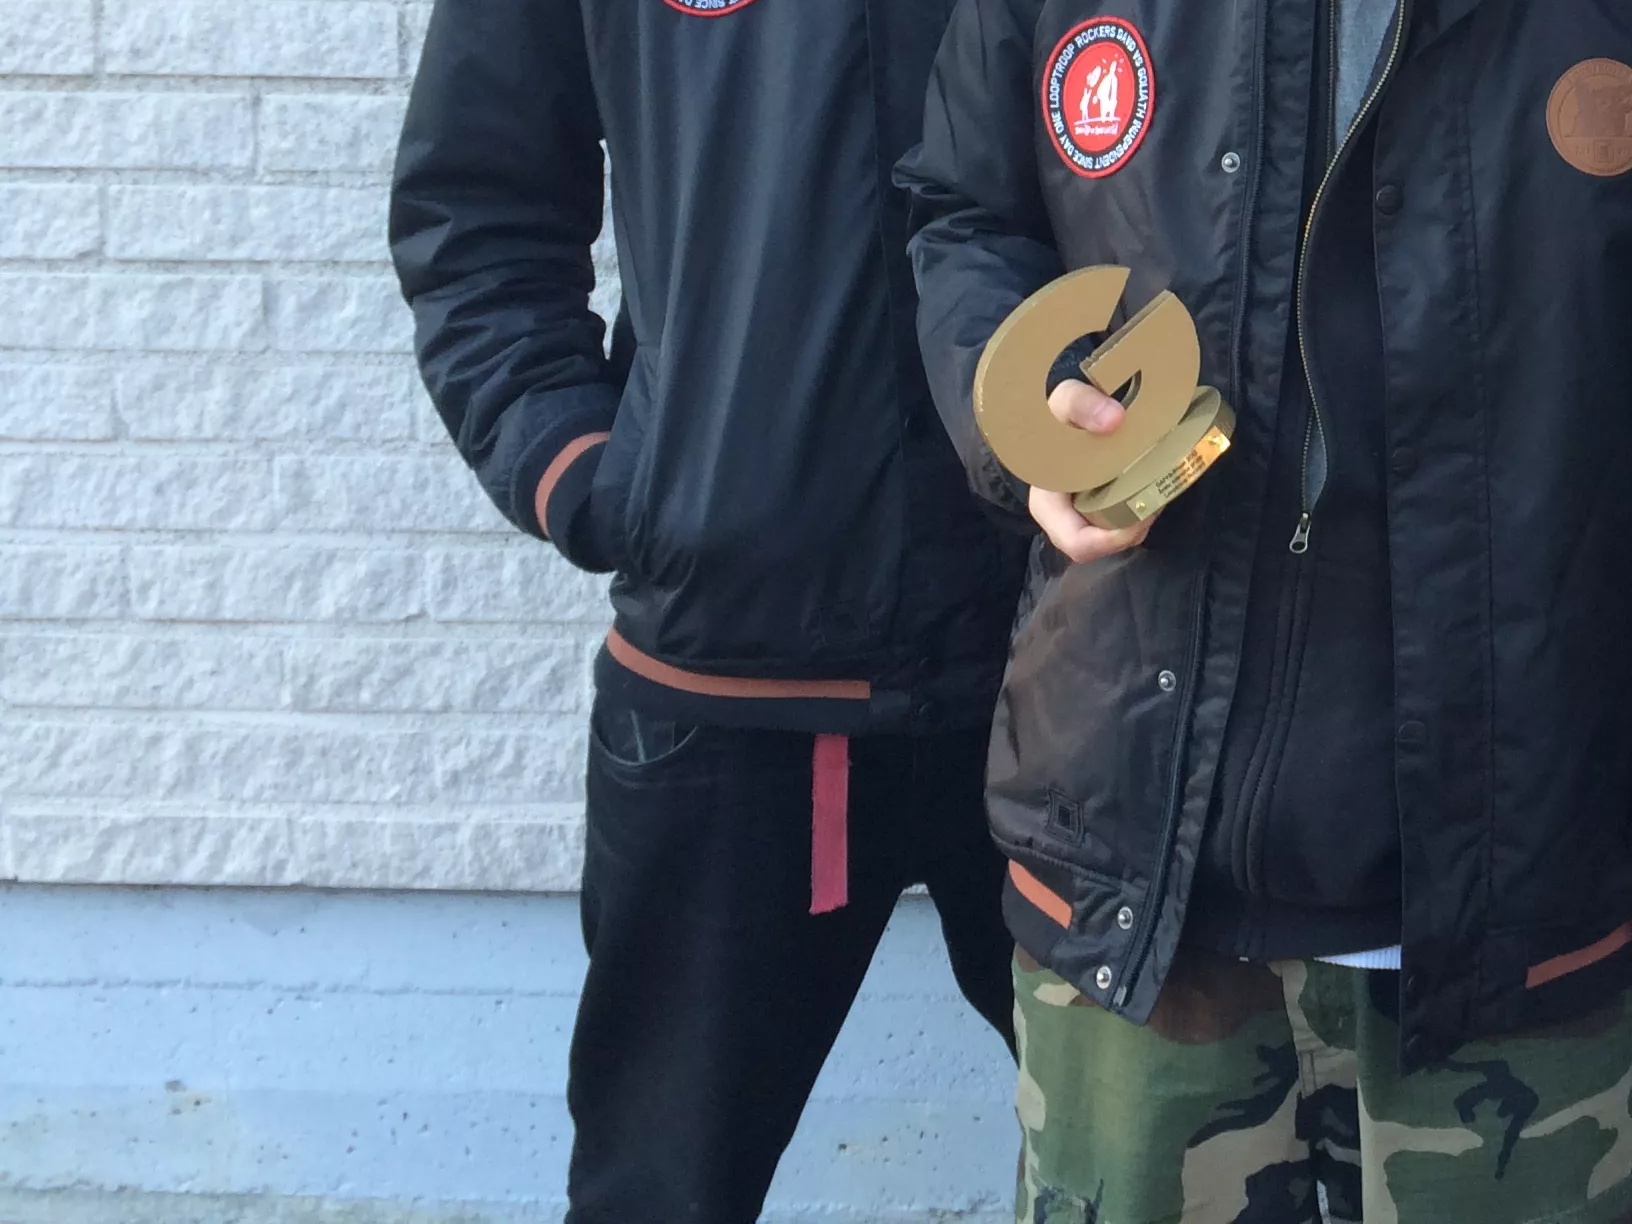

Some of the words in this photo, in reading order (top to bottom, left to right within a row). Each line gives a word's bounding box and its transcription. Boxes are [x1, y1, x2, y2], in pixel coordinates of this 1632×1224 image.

[1074, 26, 1116, 48] ROCKERS
[1116, 26, 1136, 52] DAVID
[1133, 49, 1144, 67] VS
[1049, 44, 1075, 107] LOOPTROOP
[1136, 68, 1148, 119] GOLIATH
[1051, 111, 1065, 133] ONE
[1060, 134, 1077, 156] DAY
